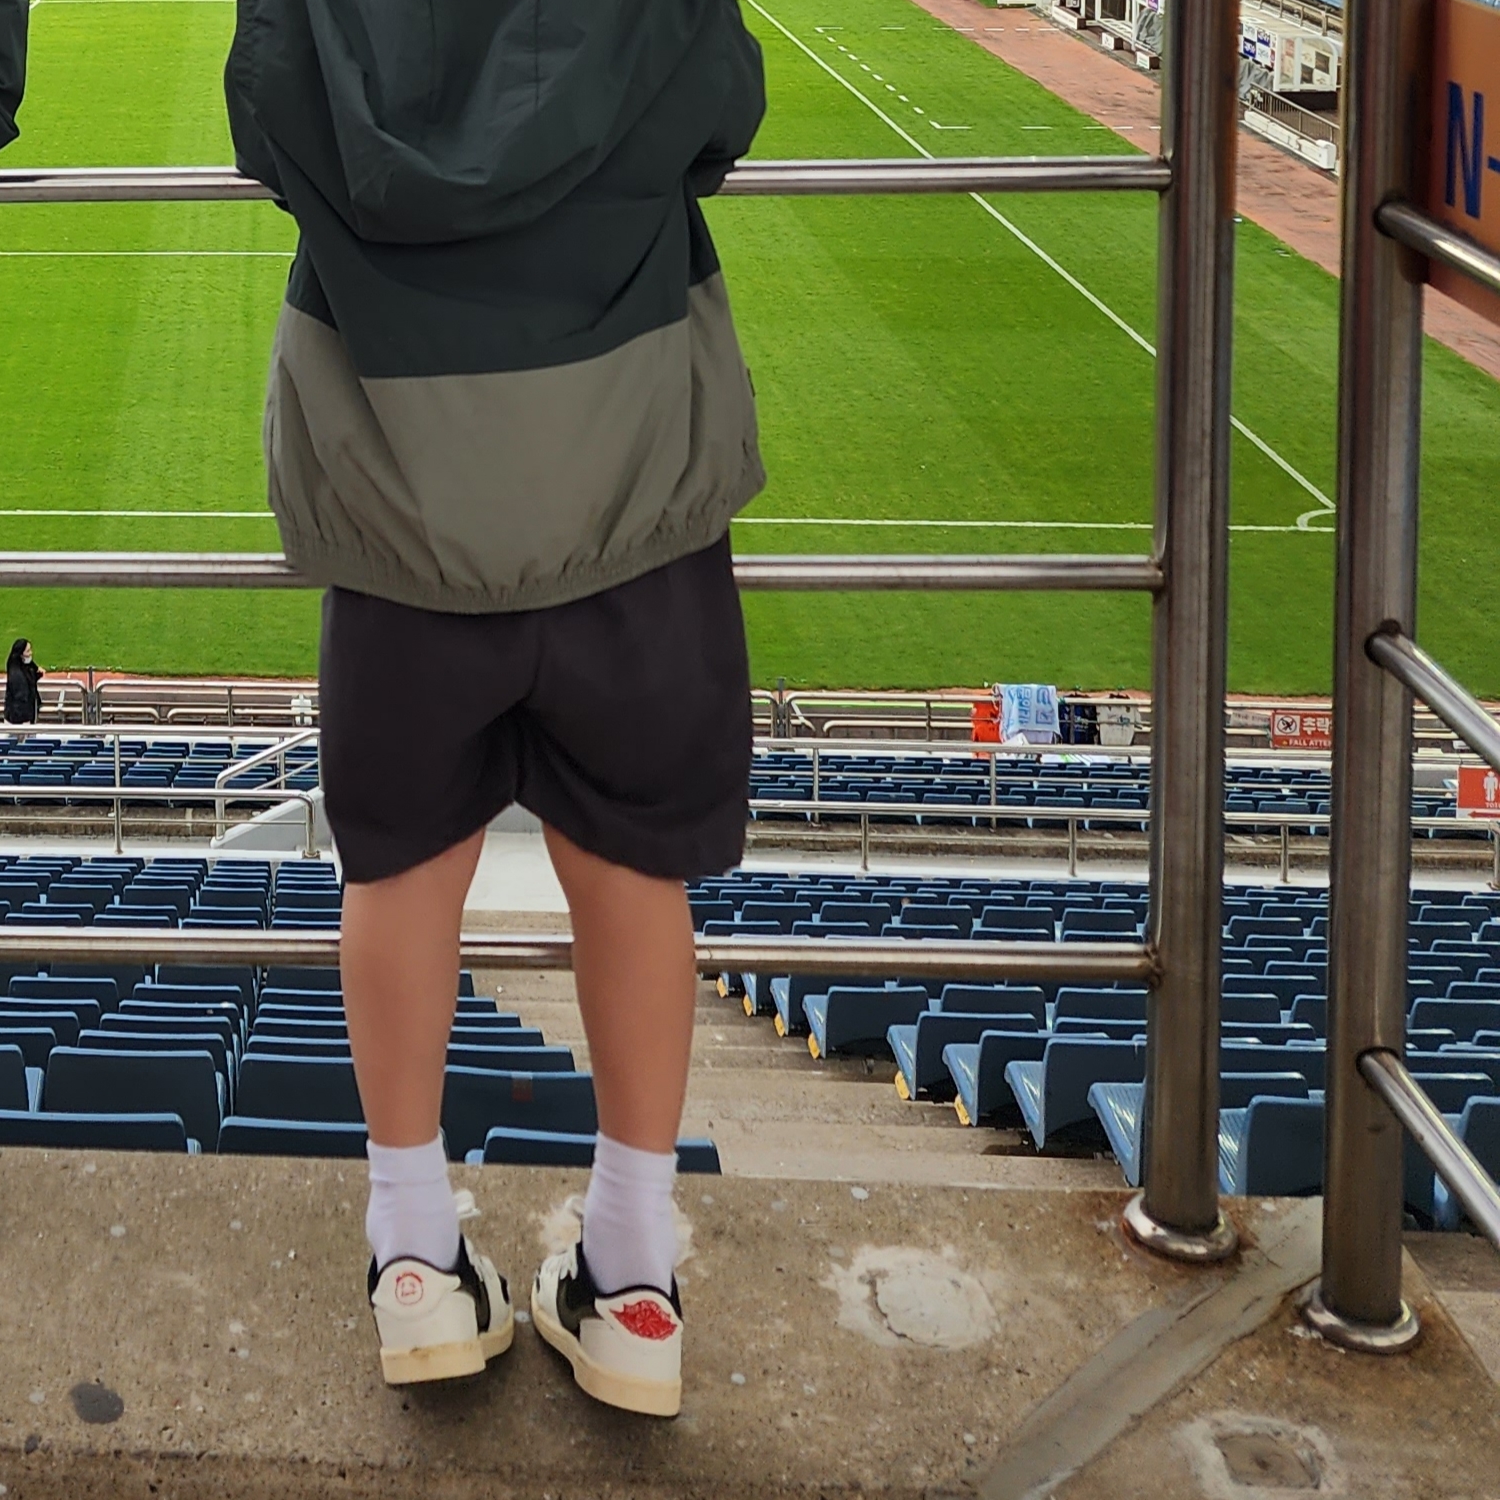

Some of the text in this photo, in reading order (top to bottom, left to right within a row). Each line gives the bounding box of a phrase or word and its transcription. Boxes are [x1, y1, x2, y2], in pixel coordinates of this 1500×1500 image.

[1303, 717, 1332, 735] 추락
[1289, 739, 1332, 748] FALL ATTE
